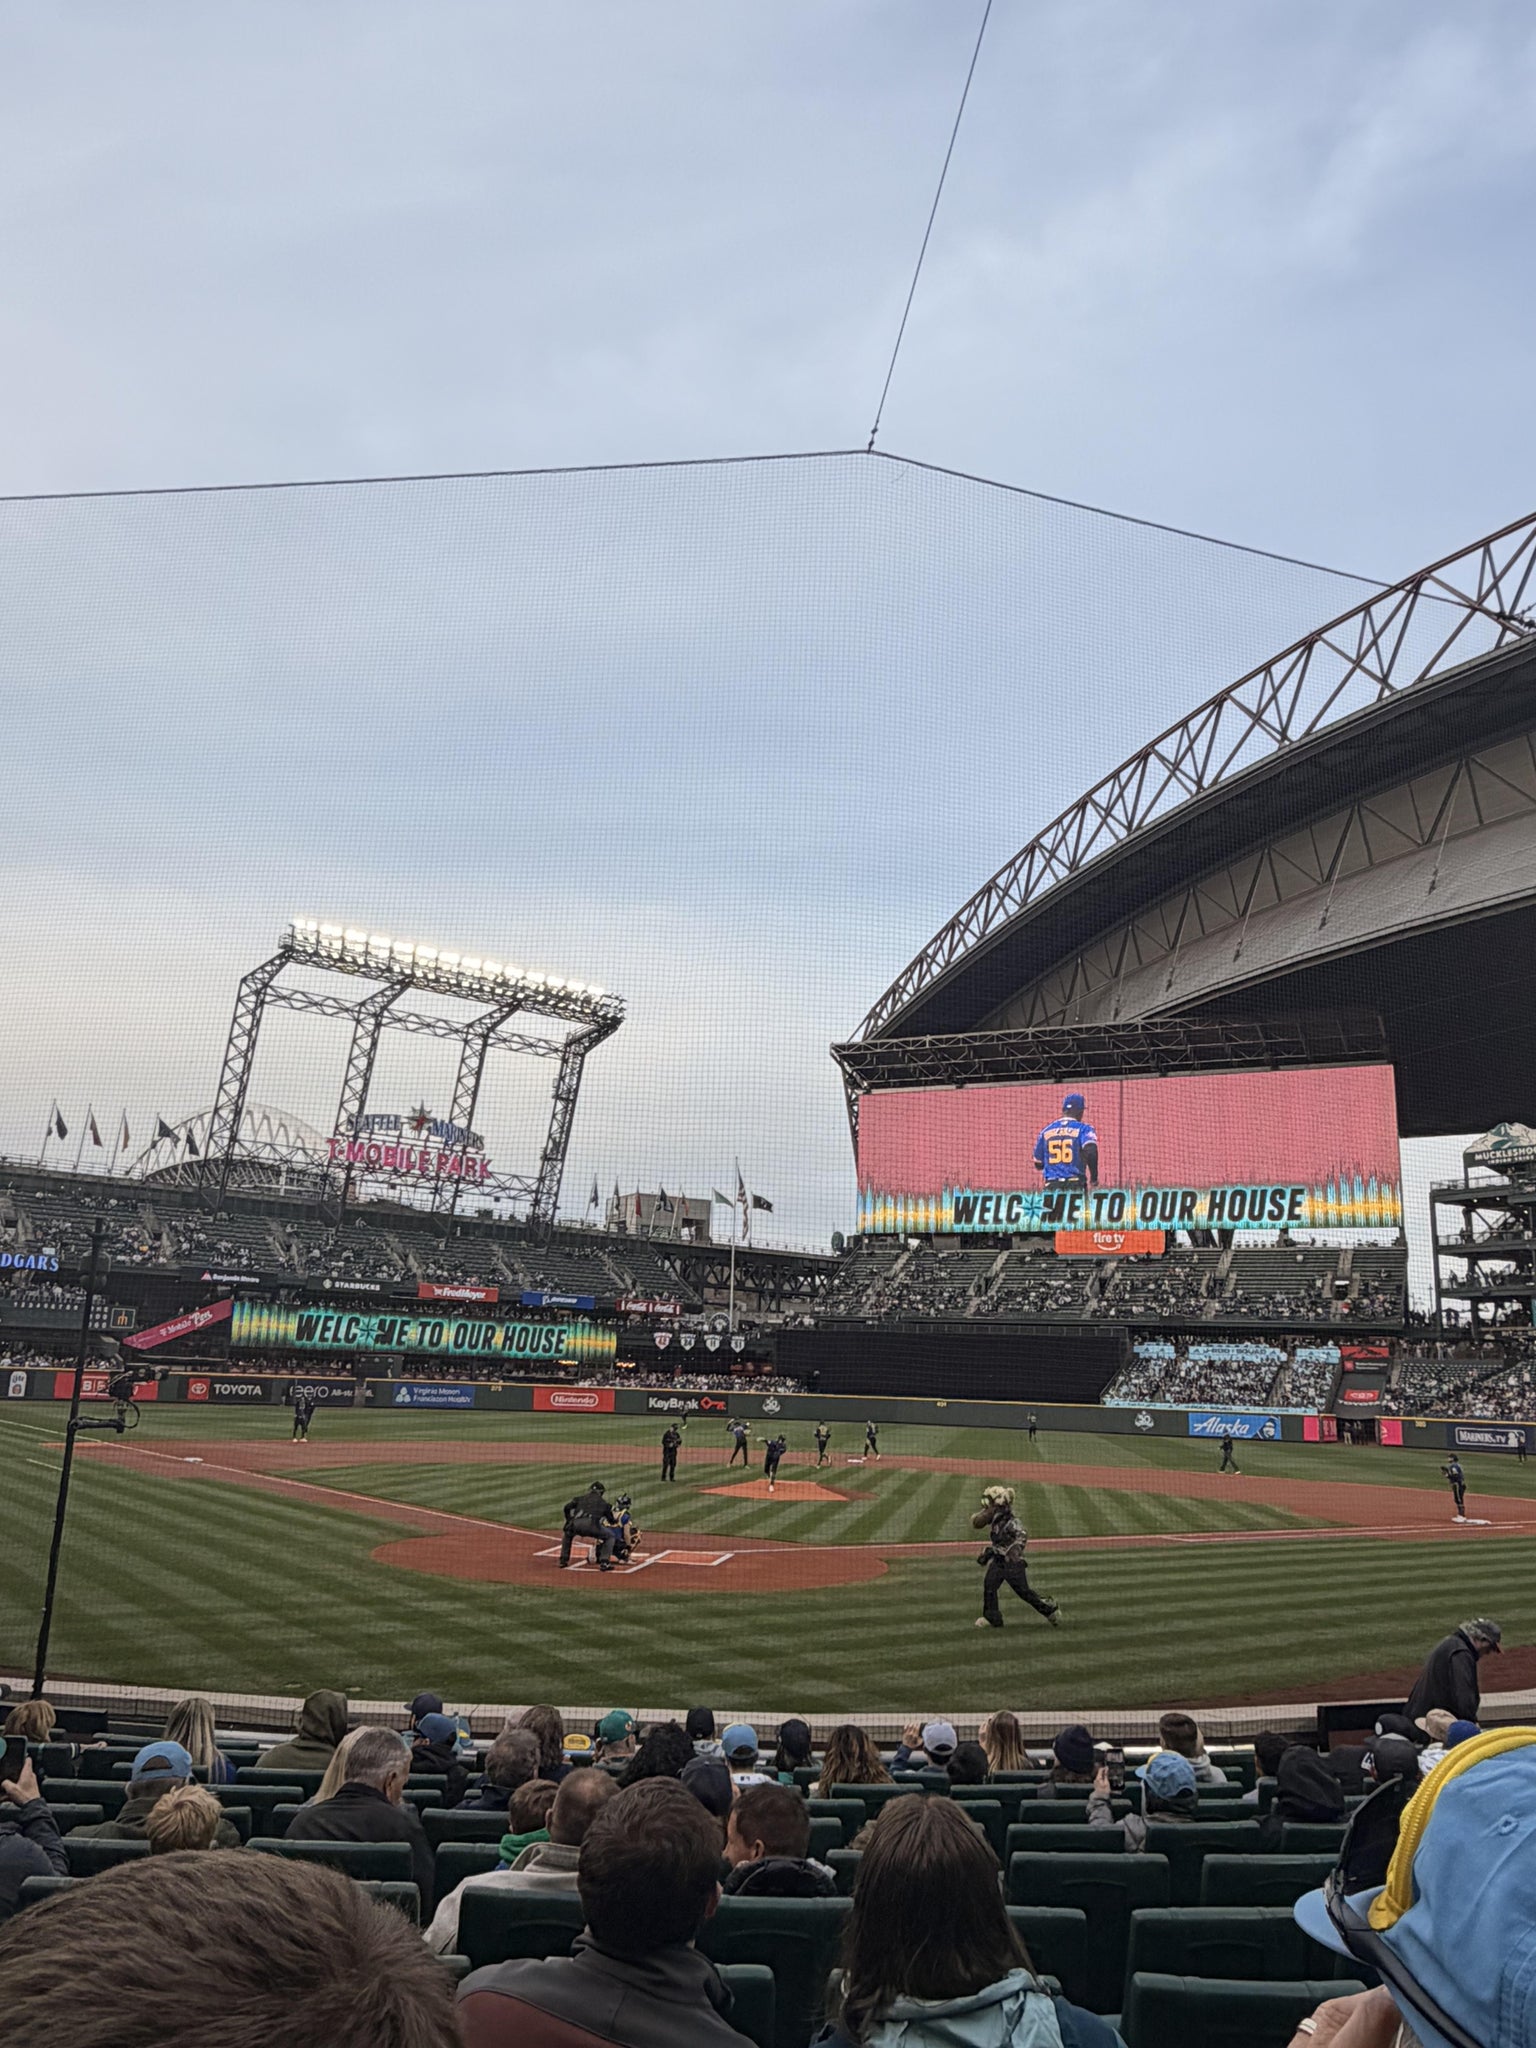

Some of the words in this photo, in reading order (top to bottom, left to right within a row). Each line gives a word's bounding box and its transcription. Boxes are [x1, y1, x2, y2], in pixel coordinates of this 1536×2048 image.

[346, 1113, 402, 1132] SEATTLE
[430, 1117, 485, 1151] MARINERS
[325, 1137, 431, 1173] T-MOBILE
[436, 1152, 493, 1179] PARK
[1048, 1139, 1073, 1164] 56
[1474, 1146, 1536, 1161] MUCKLESHO
[953, 1192, 1085, 1225] WELCME
[1092, 1191, 1127, 1223] TO
[1139, 1190, 1198, 1223] OUR
[1206, 1188, 1306, 1222] HOUSE
[1093, 1232, 1113, 1244] fire
[1113, 1232, 1126, 1244] tv
[334, 1280, 381, 1291] STARBUCKS
[188, 1310, 214, 1329] Pen
[295, 1312, 410, 1347] WELCME
[416, 1320, 445, 1349] TO
[452, 1322, 496, 1352] OUR
[500, 1326, 568, 1355] HOUSE
[213, 1383, 263, 1396] TOYOTA
[413, 1387, 438, 1397] Virginia
[554, 1395, 595, 1405] Nintendo
[1193, 1416, 1250, 1437] Alaska
